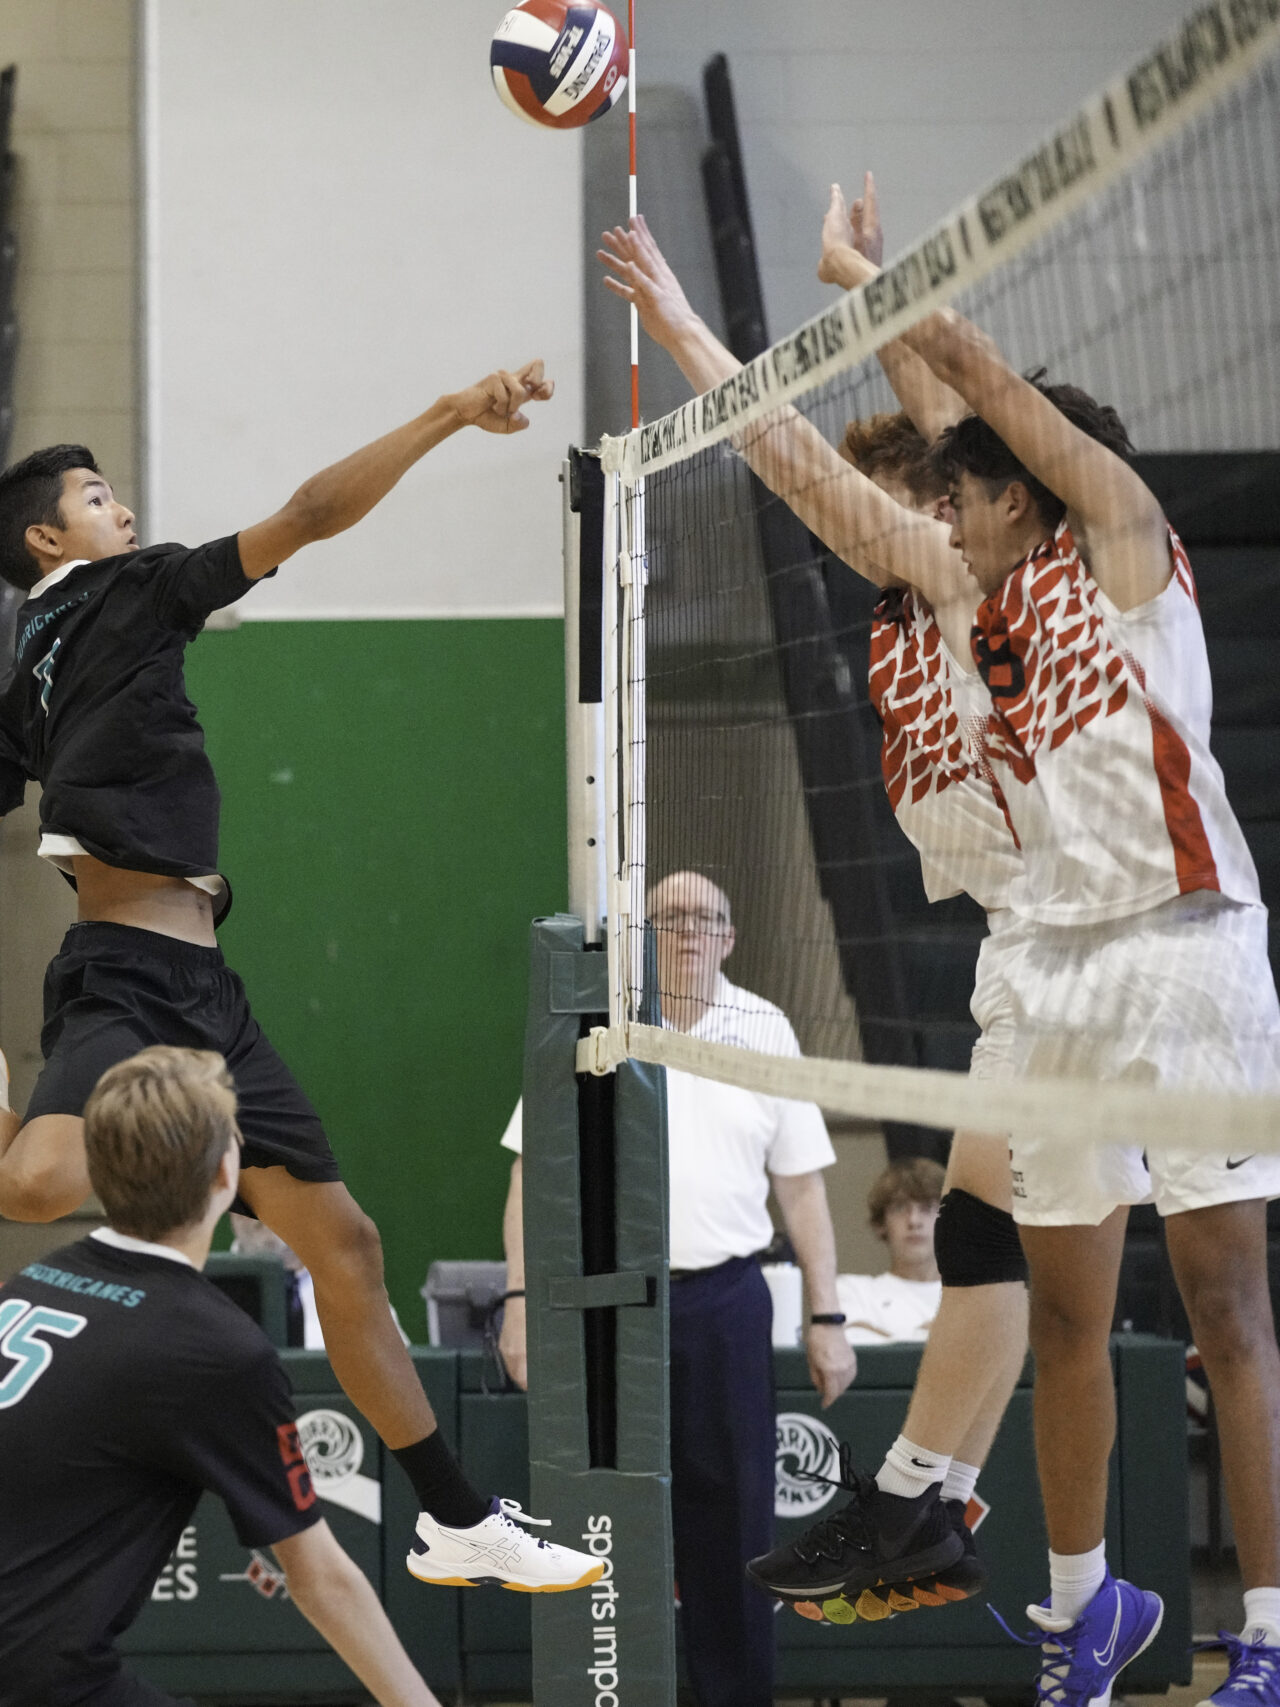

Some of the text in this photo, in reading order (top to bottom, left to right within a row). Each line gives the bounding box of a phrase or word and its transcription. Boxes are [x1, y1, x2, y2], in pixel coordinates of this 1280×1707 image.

[563, 30, 612, 100] SPALDING
[17, 591, 89, 664] HURRICA
[19, 1262, 146, 1308] HURRICANES
[581, 1515, 620, 1620] sports
